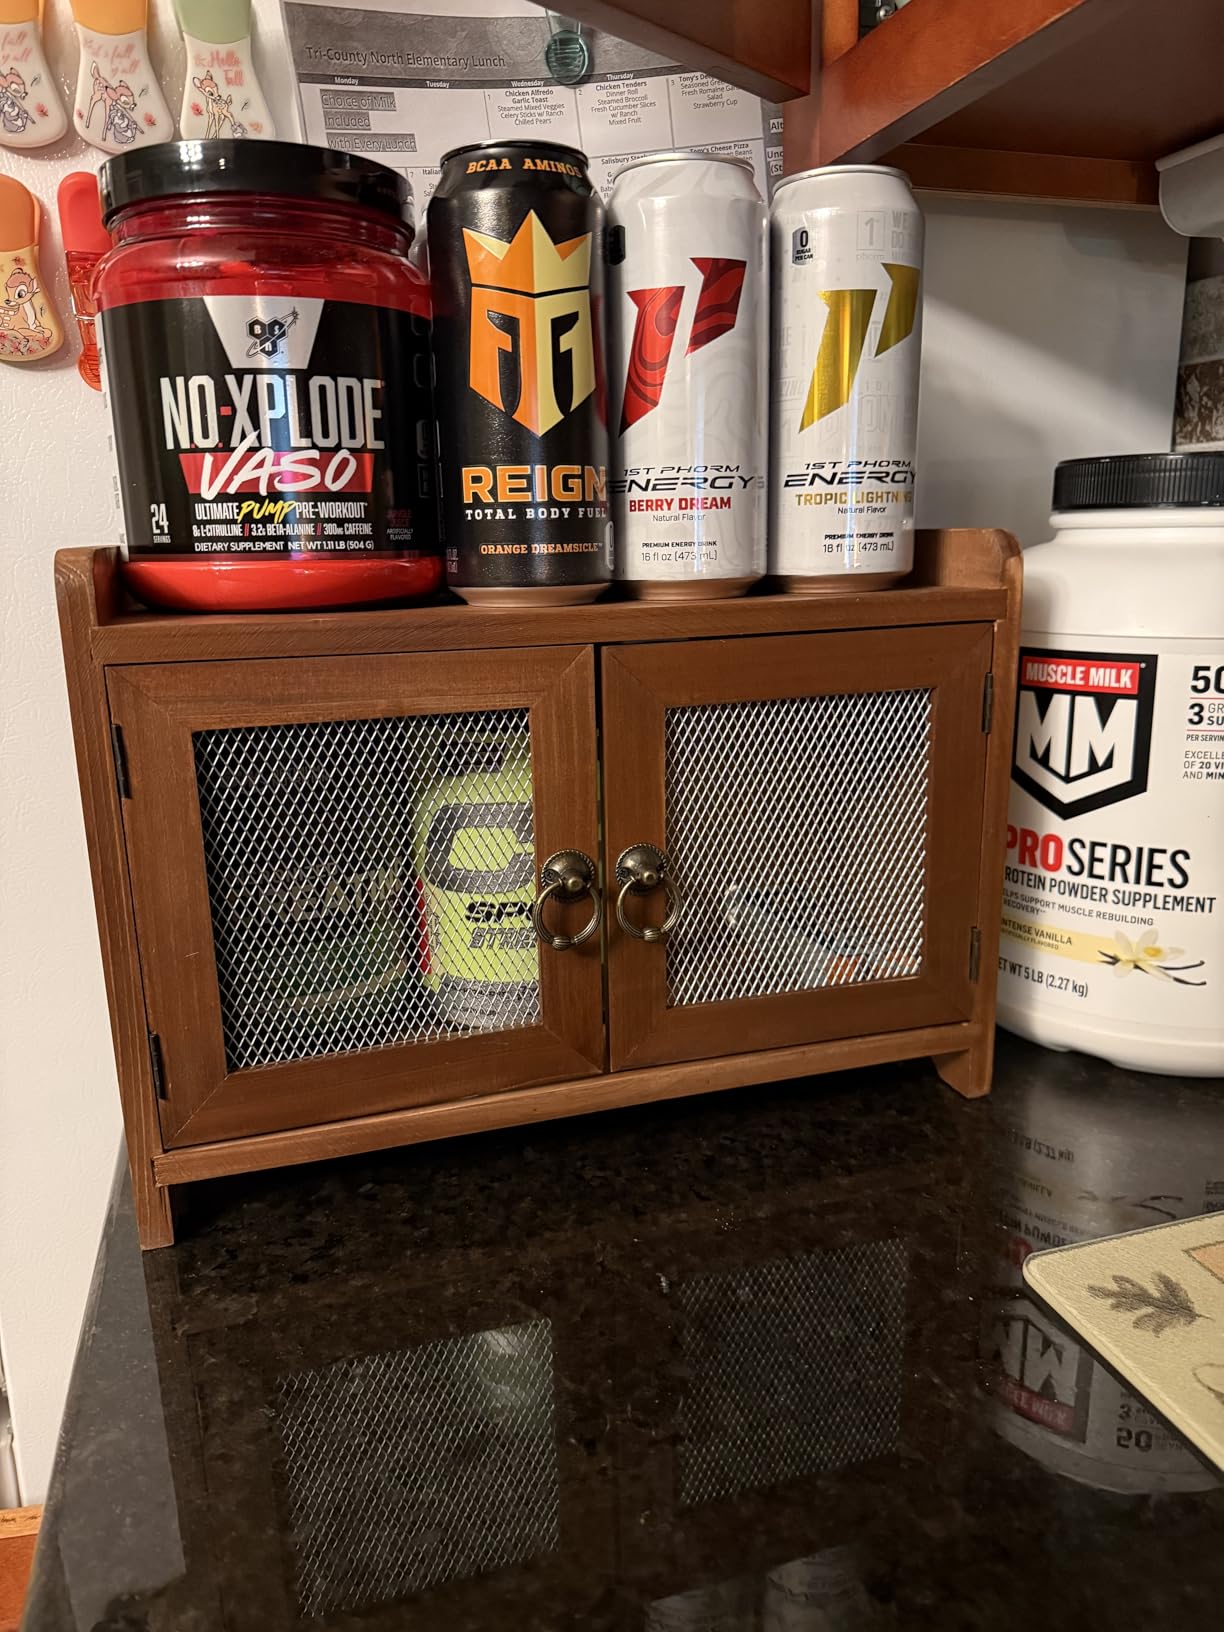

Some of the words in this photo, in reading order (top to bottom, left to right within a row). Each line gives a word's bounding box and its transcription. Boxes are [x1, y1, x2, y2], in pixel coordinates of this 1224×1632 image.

[305, 46, 368, 66] Tri-County
[371, 53, 404, 65] North
[406, 54, 469, 70] Elementary
[472, 56, 506, 67] Lunch
[334, 77, 360, 86] Monday
[426, 80, 450, 88] Tuesday
[606, 73, 634, 81] Thursday
[679, 74, 699, 83] Tony's
[596, 84, 621, 92] Chicken
[680, 80, 709, 90] Seasoned
[682, 88, 698, 96] Fresh
[321, 94, 358, 108] Choice
[360, 94, 372, 108] of
[374, 96, 396, 109] Milk
[598, 98, 623, 106] Steamed
[693, 101, 725, 110] Strawberry
[726, 99, 738, 107] Cup
[324, 114, 370, 128] Included
[328, 136, 350, 150] with
[354, 137, 382, 152] Every
[384, 138, 416, 150] Lunch
[710, 144, 732, 152] Cheese
[466, 158, 512, 174] BCAA
[522, 158, 583, 178] AMINOS
[601, 156, 630, 166] Salisbury
[800, 230, 808, 248] 0
[200, 429, 357, 500] VASO
[624, 467, 656, 477] 1ST
[660, 465, 740, 474] PHORM
[805, 461, 842, 470] 1ST
[847, 460, 912, 469] PHORM
[462, 464, 607, 504] REIGN
[608, 476, 757, 494] ENERGY
[784, 470, 916, 488] ENERGY
[630, 498, 674, 512] BERRY
[678, 496, 732, 511] DREAM
[796, 492, 848, 506] TROPIC
[194, 502, 240, 520] ULTIMATE
[237, 498, 296, 524] PUMP
[296, 502, 367, 518] PRE-WORKOUT
[466, 508, 516, 520] TOTAL
[526, 508, 571, 520] BODY
[578, 506, 607, 518] FUEL
[652, 514, 680, 522] Natural
[150, 503, 169, 534] 24
[201, 524, 244, 536] L-CITRULLINE
[266, 523, 316, 536] BETA-ALANINE
[344, 523, 373, 535] CAFFEINE
[194, 542, 229, 552] DIETARY
[230, 541, 285, 551] SUPPLEMENT
[288, 542, 305, 550] NET
[306, 542, 322, 550] WT
[322, 542, 335, 550] 1.11
[336, 541, 346, 550] LB
[346, 540, 365, 550] (504
[365, 540, 374, 550] G)
[480, 544, 528, 555] ORANGE
[642, 552, 650, 562] 16
[653, 552, 658, 561] fl
[1026, 662, 1086, 686] MUSCLE
[1089, 667, 1134, 688] MILK
[1188, 703, 1204, 726] 3
[1184, 760, 1196, 769] OF
[1198, 762, 1212, 770] 20
[1182, 771, 1202, 780] AND
[1066, 838, 1191, 890] SERIES
[1004, 866, 1046, 892] ROTEIN
[1049, 878, 1108, 904] POWDER
[1112, 889, 1216, 914] SUPPLEMENT
[1020, 894, 1056, 910] SUPPORT
[1058, 904, 1094, 918] MUSCLE
[1096, 911, 1154, 926] REBUILDING
[1034, 928, 1072, 945] VANILLA
[1009, 961, 1022, 976] WT
[1024, 968, 1030, 980] 5
[1031, 969, 1044, 984] LB
[1046, 973, 1070, 992] (2.27
[1072, 980, 1088, 998] kg)
